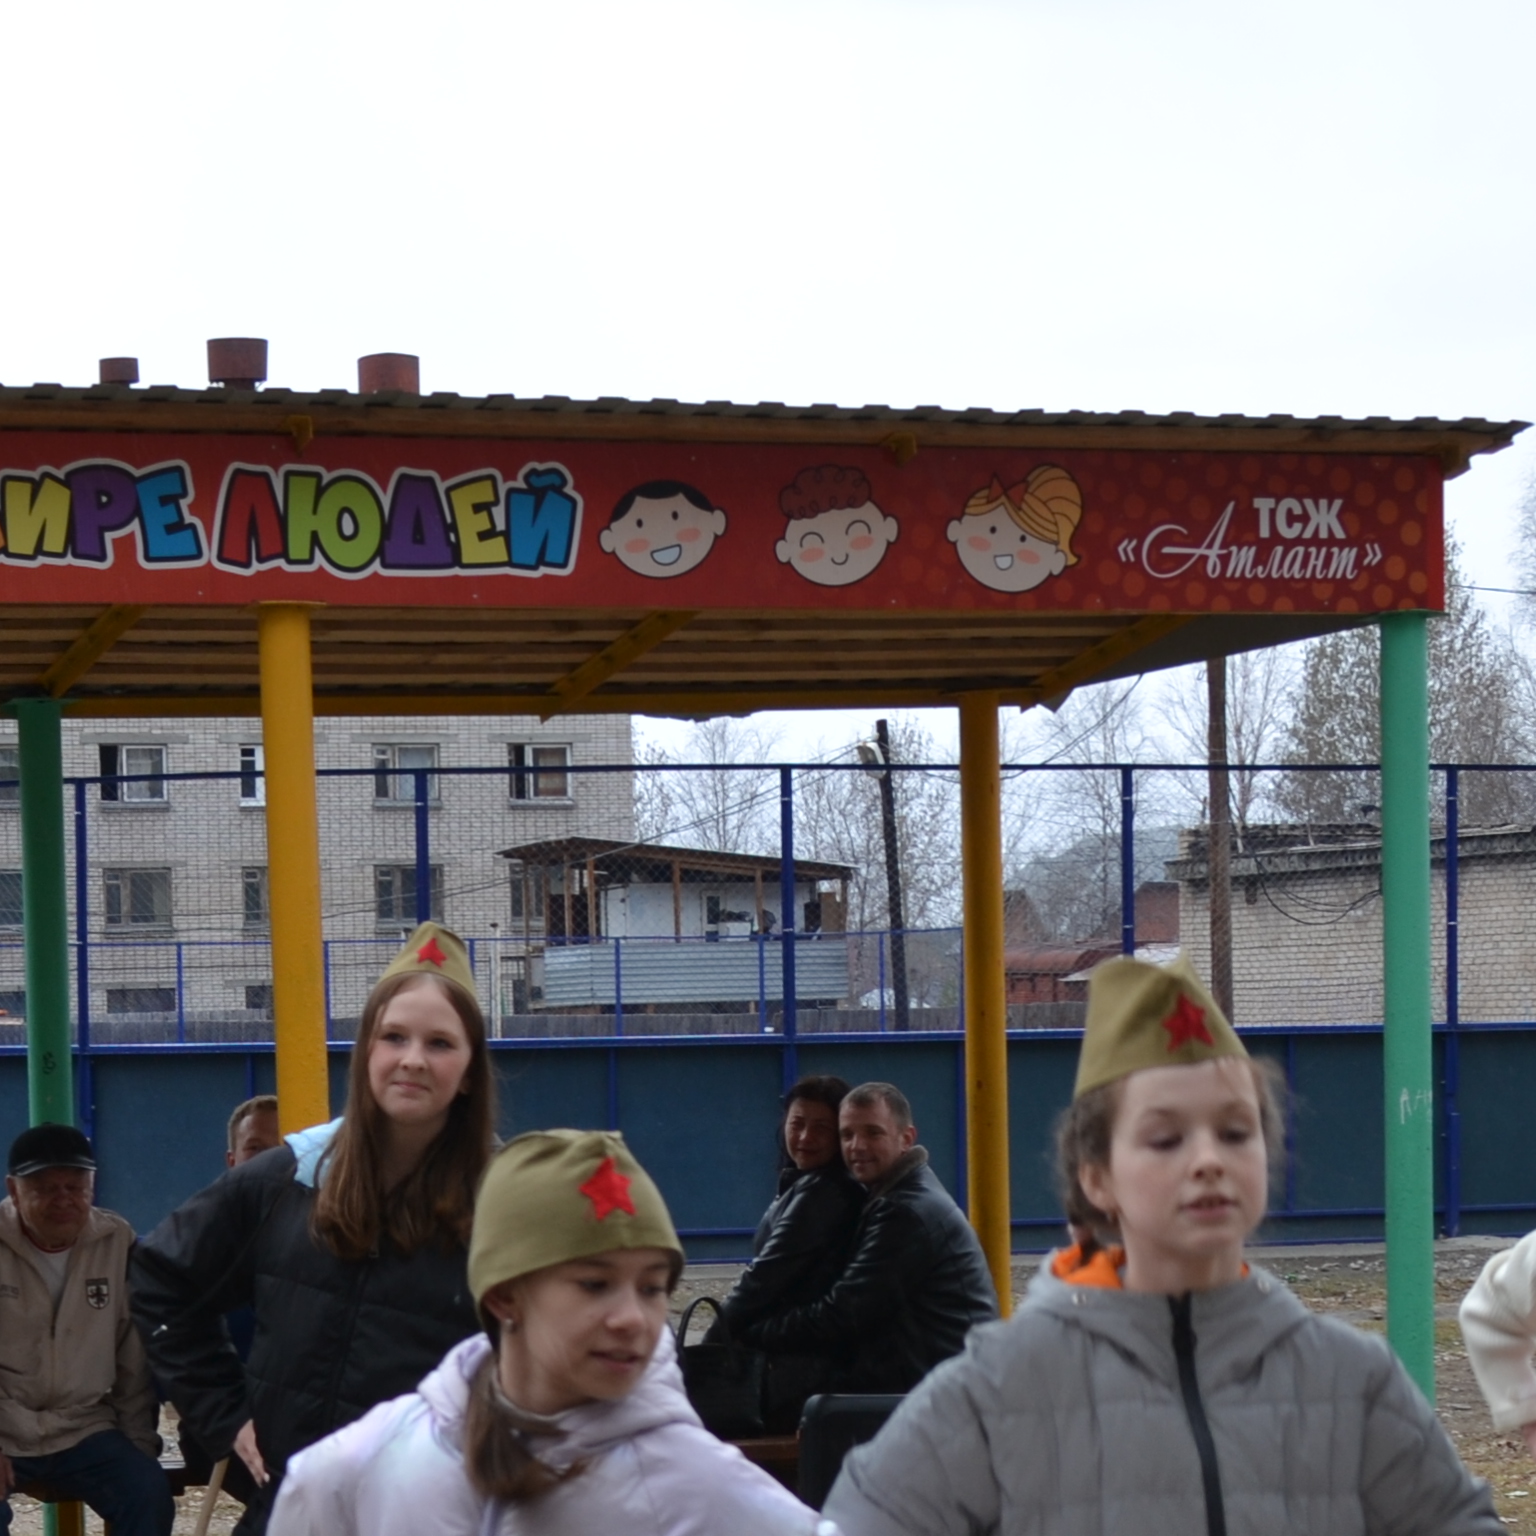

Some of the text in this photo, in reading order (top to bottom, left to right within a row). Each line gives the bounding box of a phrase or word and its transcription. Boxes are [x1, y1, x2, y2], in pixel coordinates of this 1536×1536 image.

[214, 460, 579, 577] ЛЮДЕЙ
[1117, 501, 1383, 579] «Атлант»
[1253, 498, 1346, 539] ТСЖ
